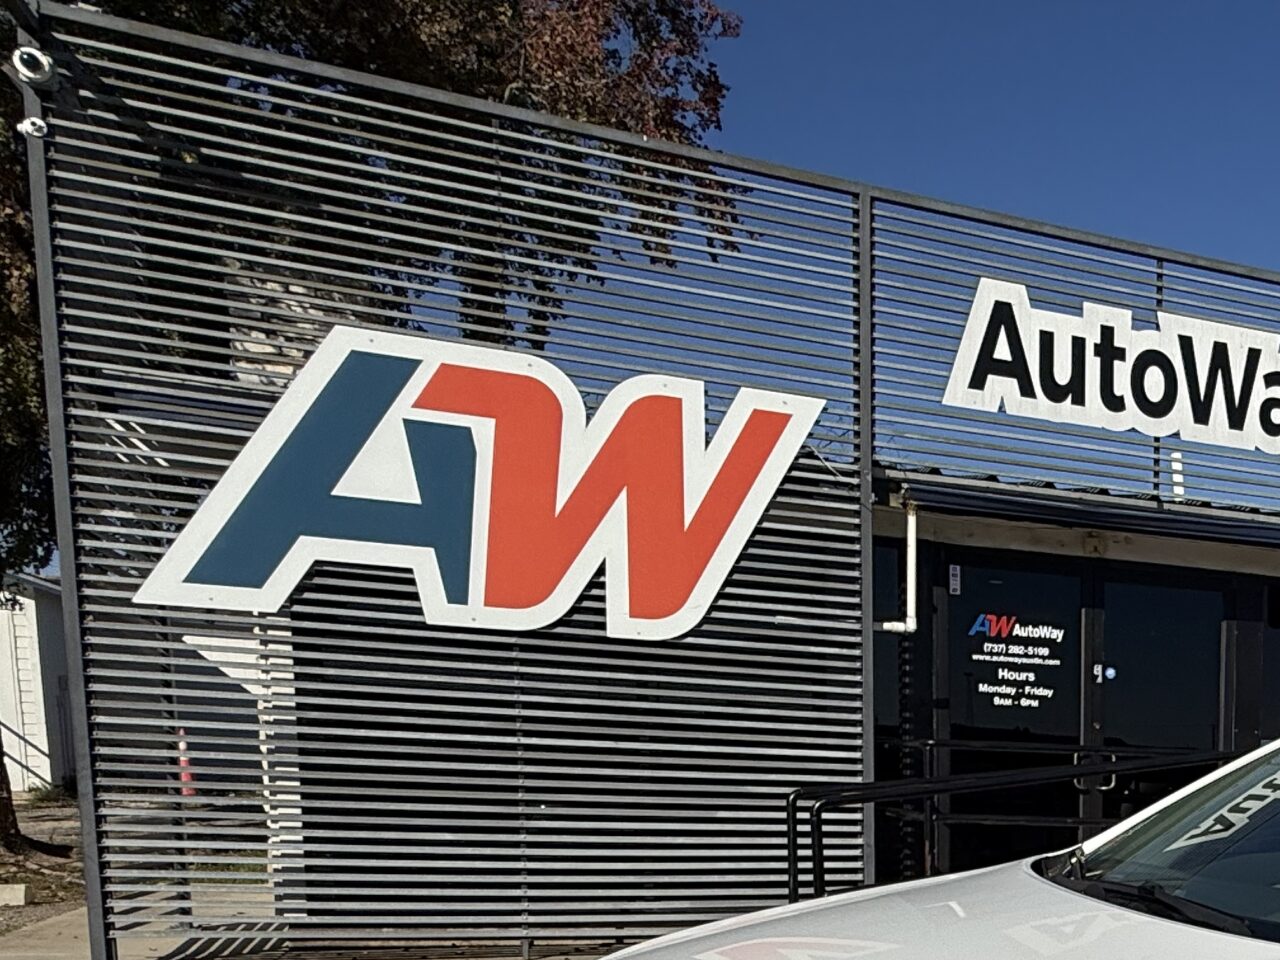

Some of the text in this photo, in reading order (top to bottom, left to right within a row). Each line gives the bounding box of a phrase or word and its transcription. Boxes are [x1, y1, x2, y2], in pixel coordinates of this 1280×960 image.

[181, 349, 795, 622] AW
[968, 613, 1065, 642] AW AutoWay
[983, 642, 1006, 654] (737)
[998, 667, 1036, 681] Hours
[978, 683, 1017, 696] Monday
[1024, 686, 1054, 698] Friday
